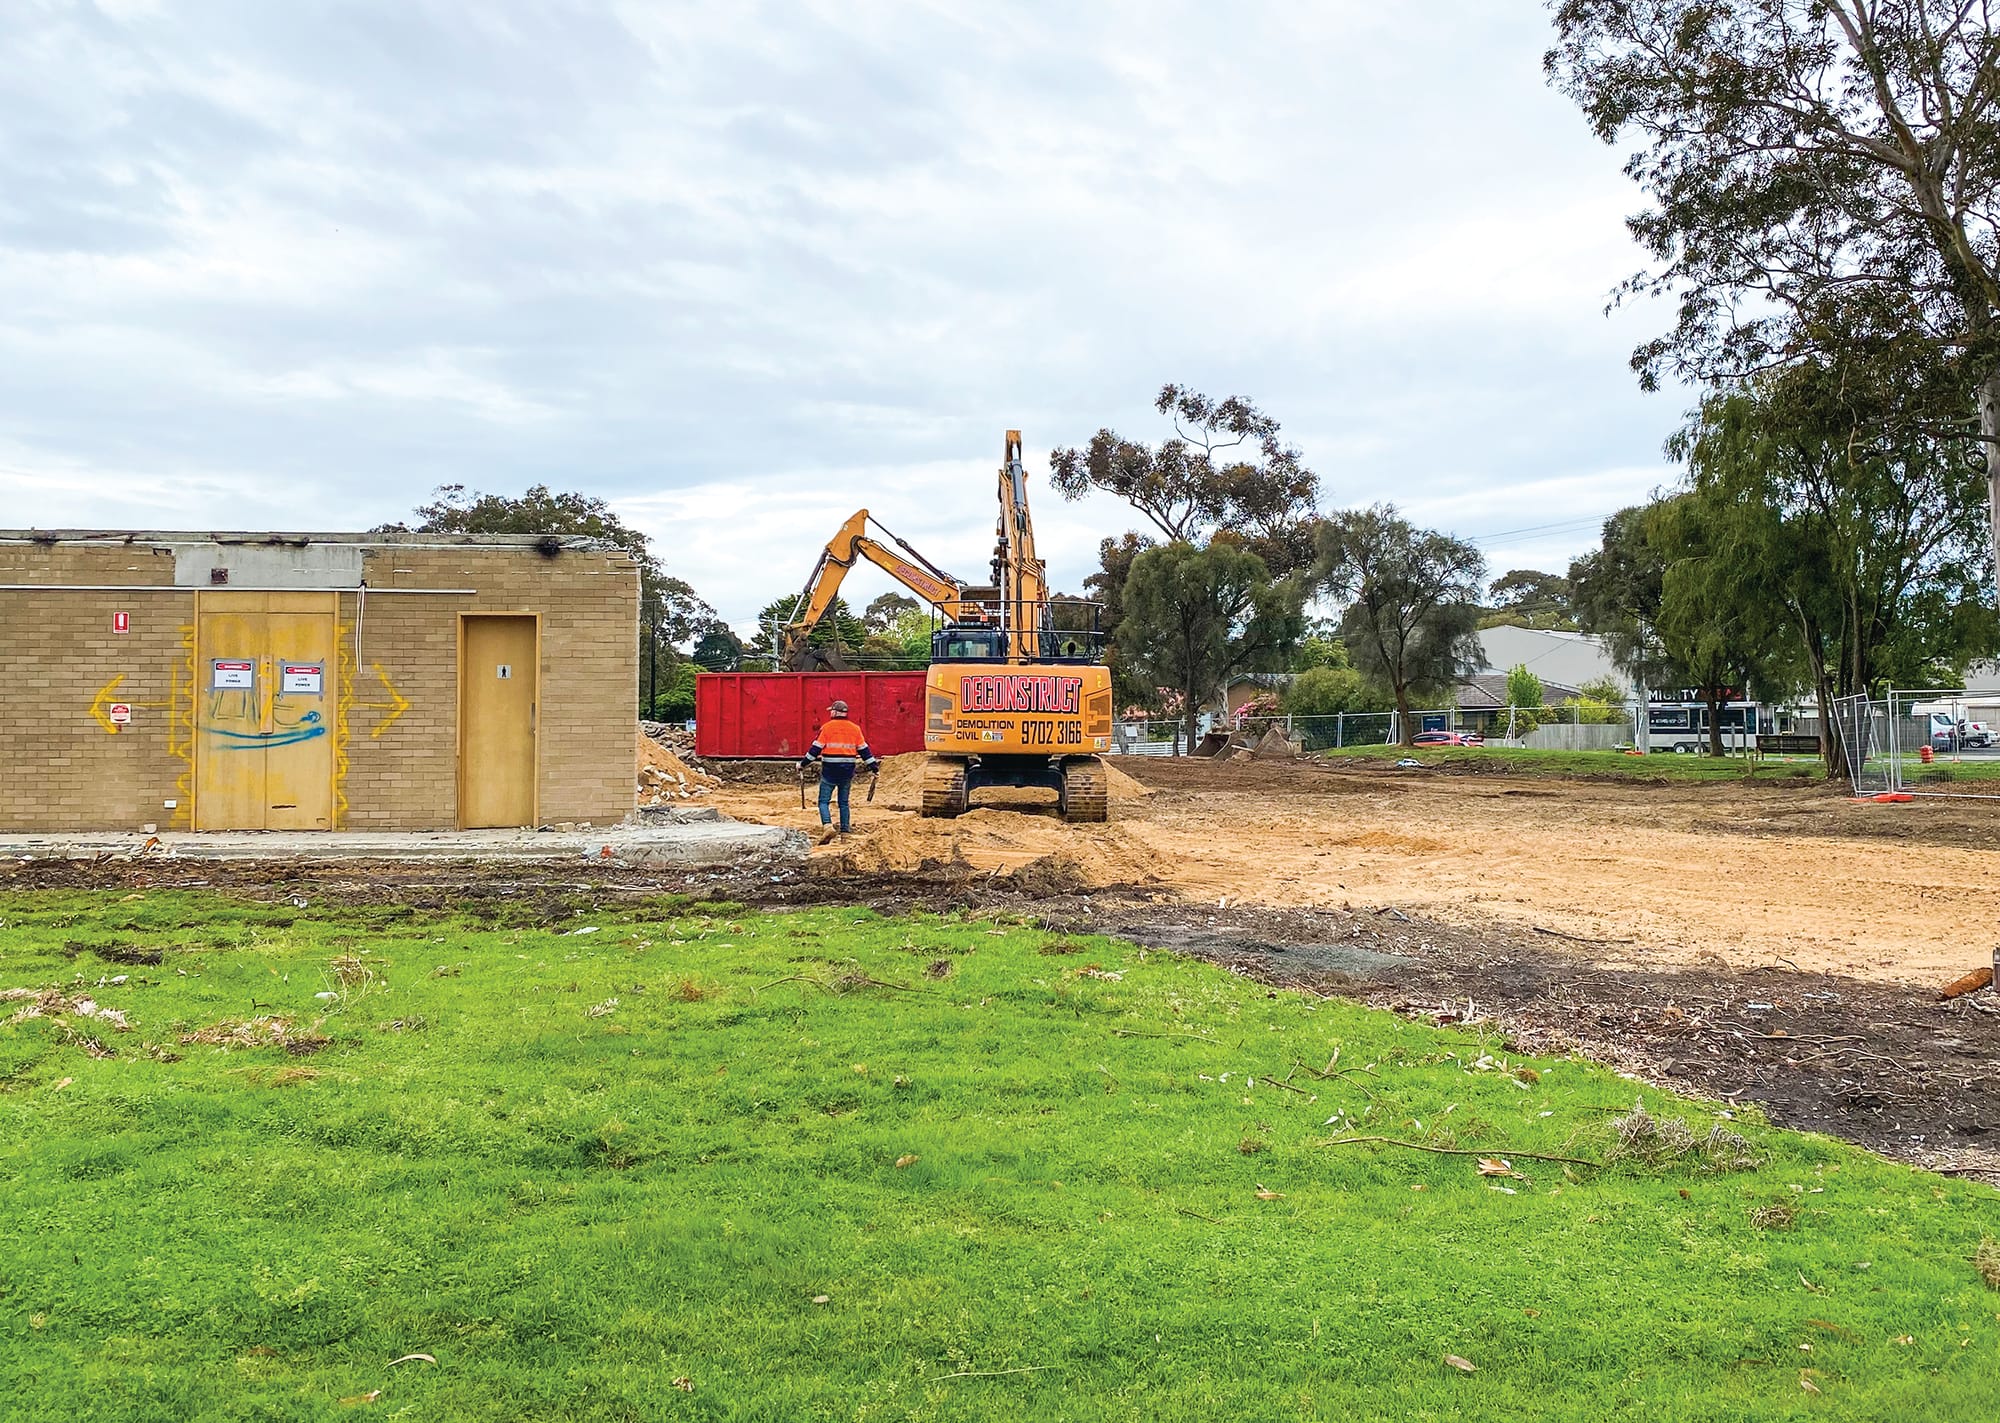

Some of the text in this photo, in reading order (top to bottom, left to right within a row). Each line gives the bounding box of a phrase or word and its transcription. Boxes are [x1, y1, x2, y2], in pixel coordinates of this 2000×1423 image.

[961, 675, 1082, 713] DECONSTRUCT
[956, 719, 1015, 730] DEMOLITION
[1021, 720, 1082, 745] 9702 3166
[956, 730, 979, 741] CIVIL
